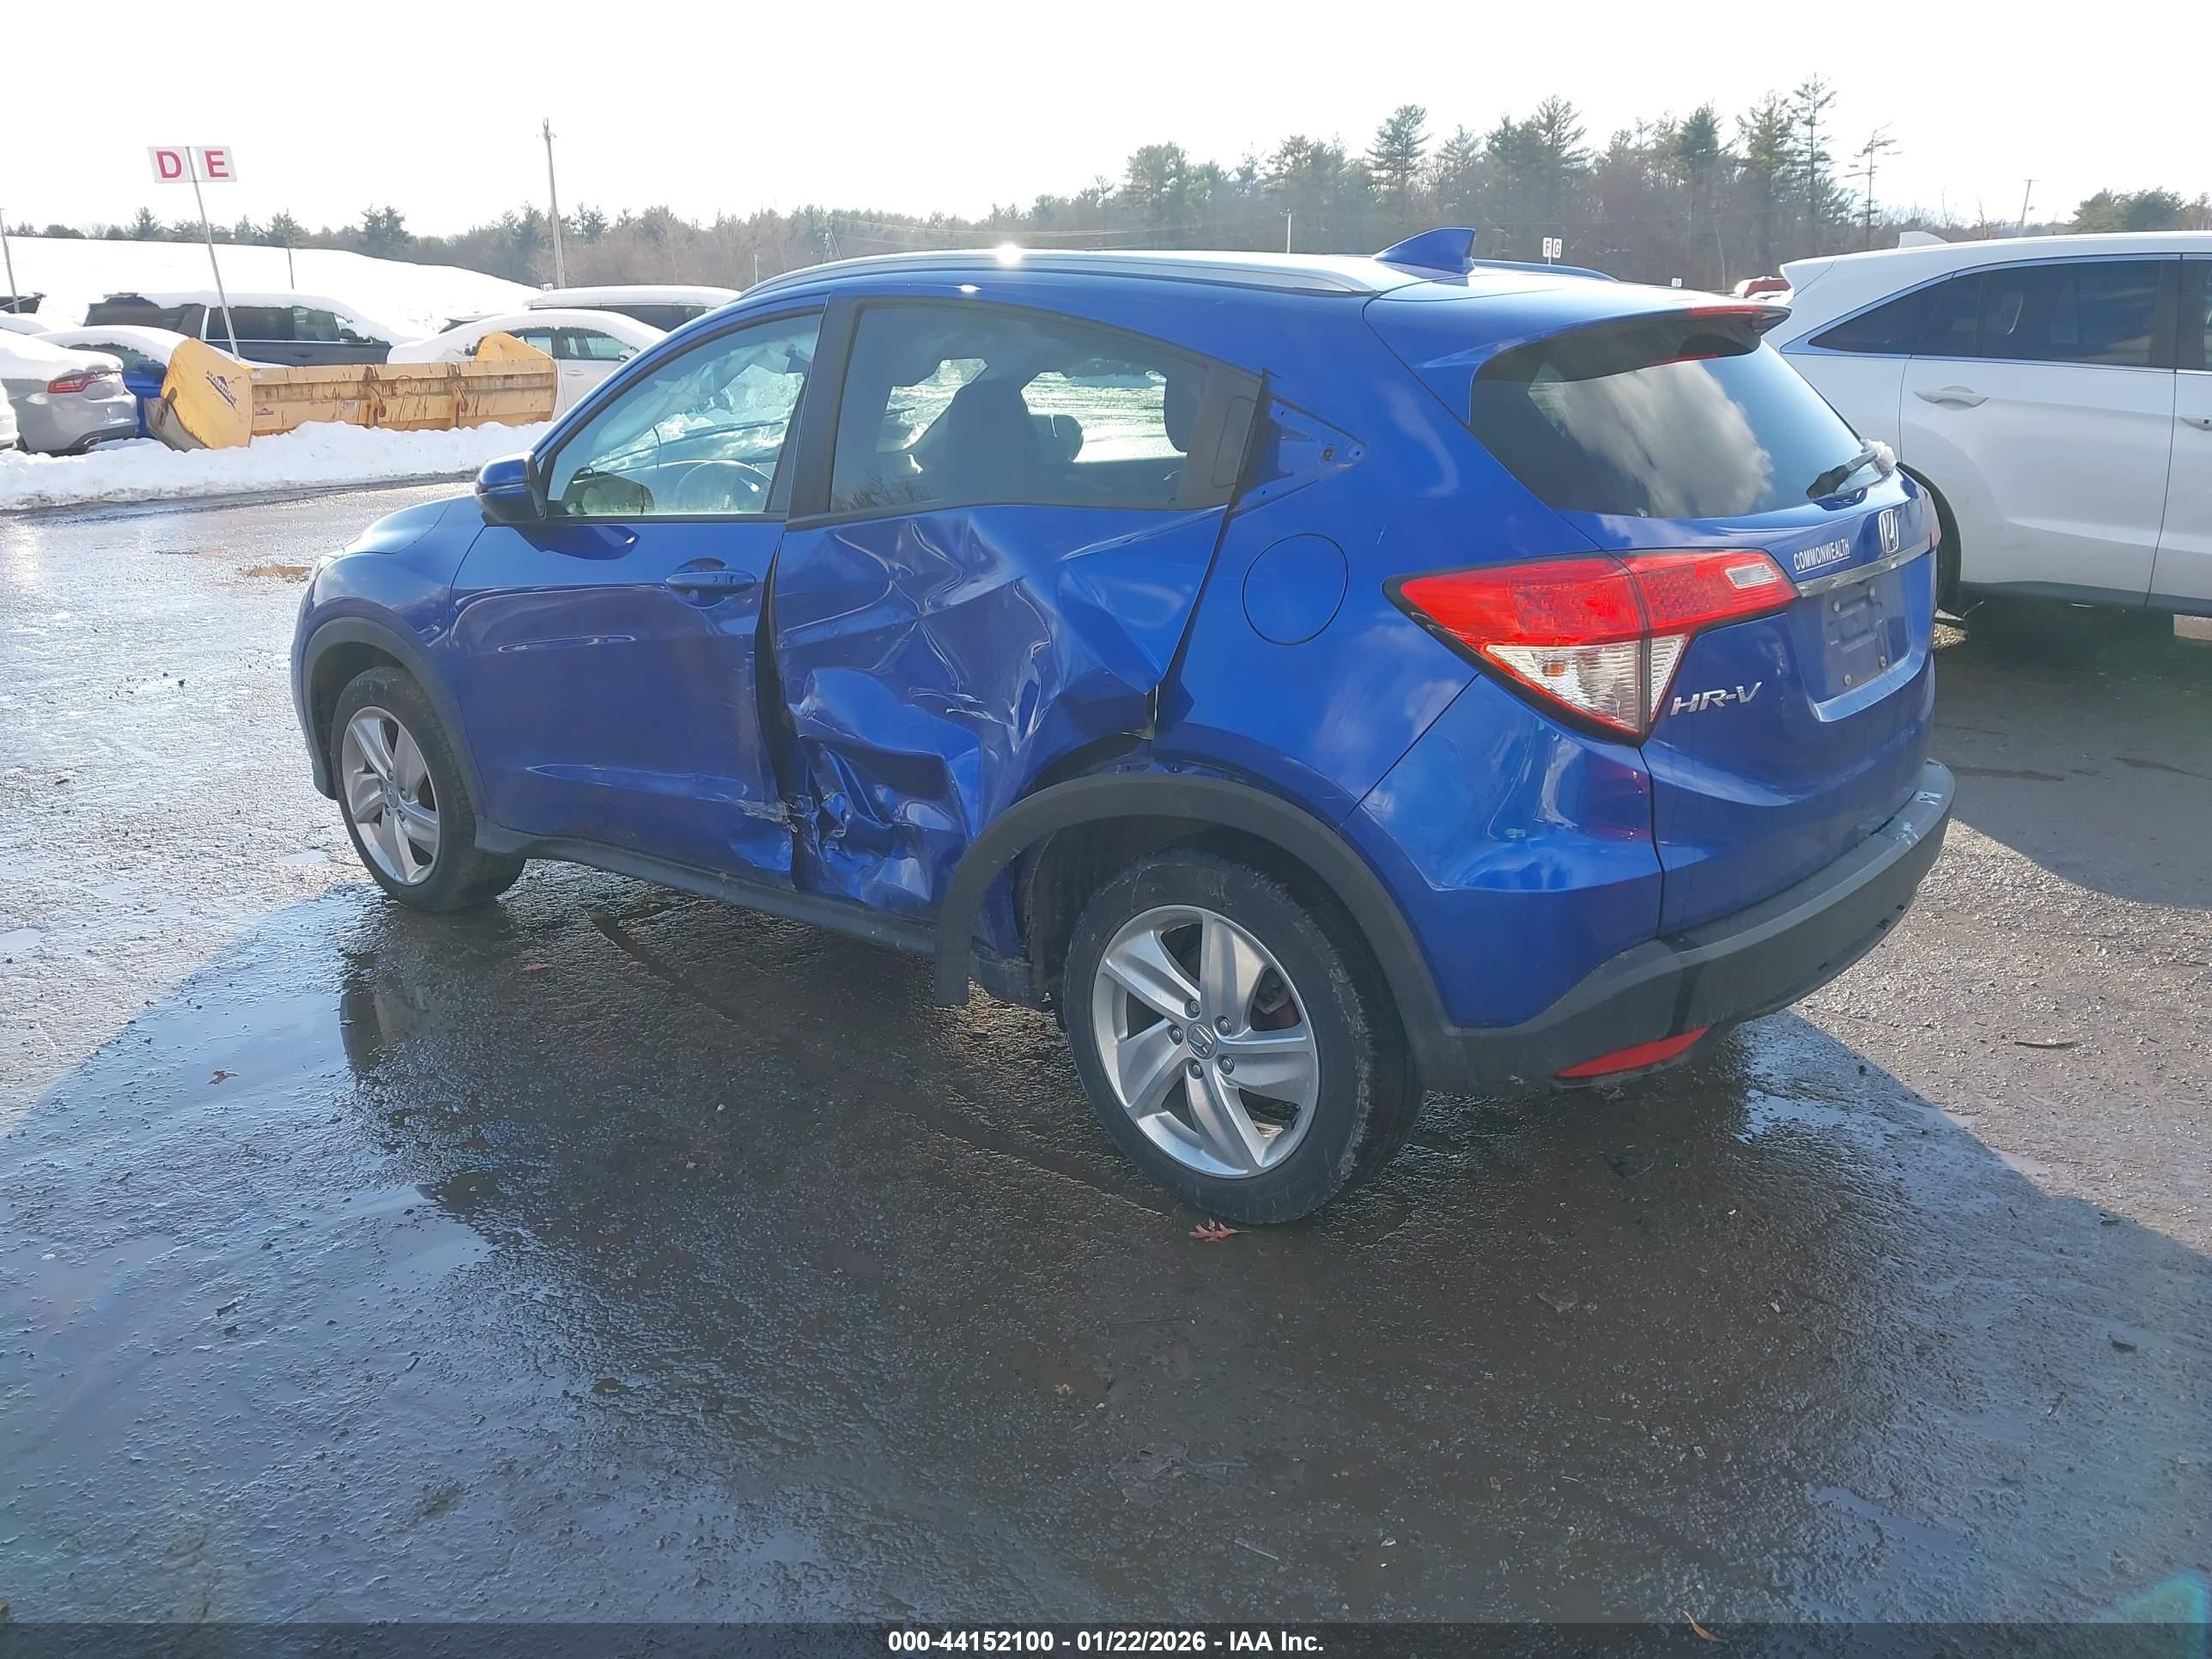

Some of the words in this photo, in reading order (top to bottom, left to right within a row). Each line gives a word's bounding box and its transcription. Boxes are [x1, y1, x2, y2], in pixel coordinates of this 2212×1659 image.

[156, 150, 182, 179] D
[204, 150, 229, 178] E
[1554, 241, 1560, 255] G
[205, 370, 237, 404] AVALANCHE
[1793, 538, 1850, 571] COMMONWEALTH
[1669, 681, 1763, 716] HR-V
